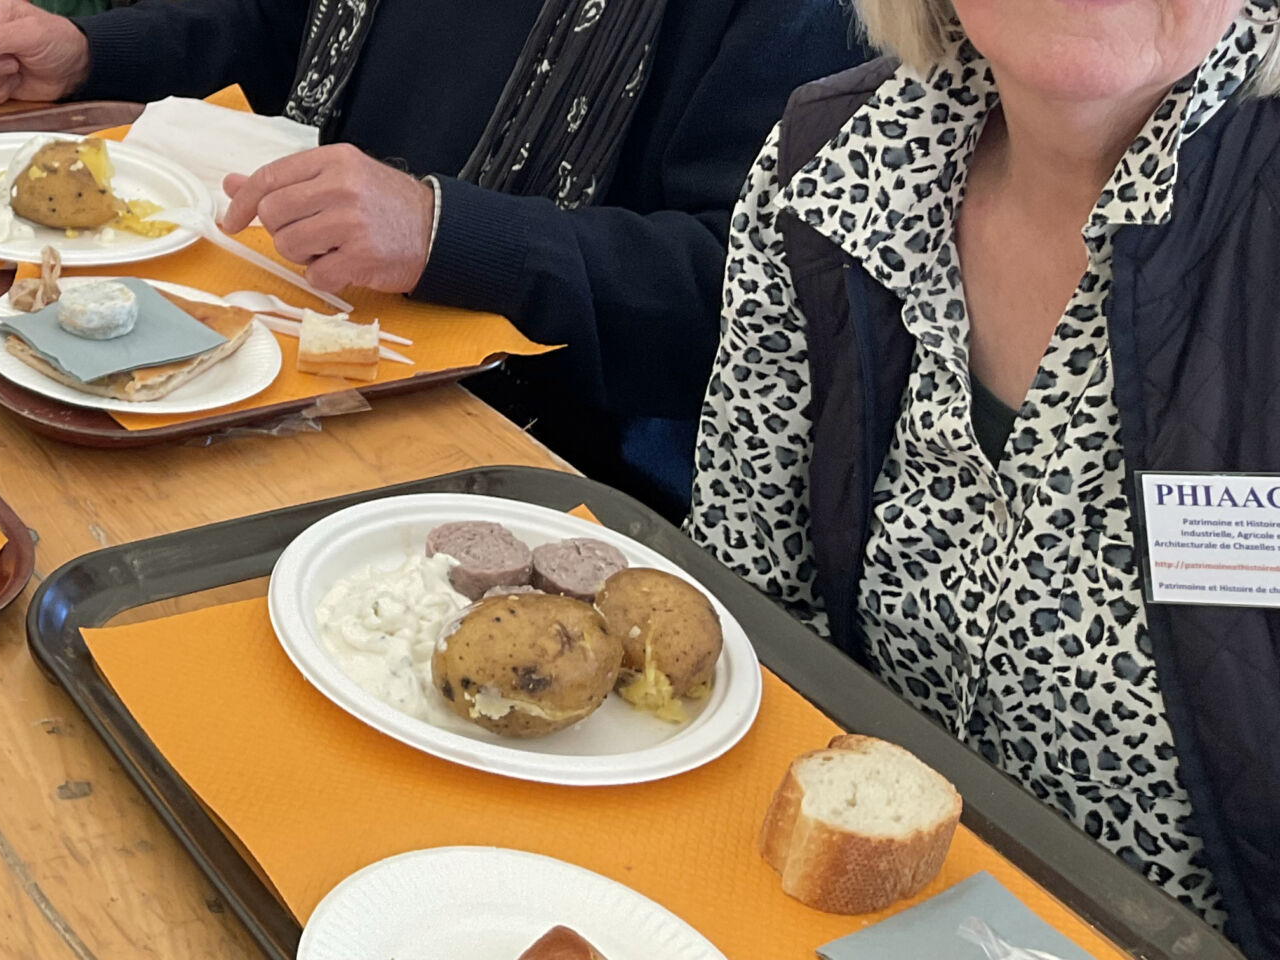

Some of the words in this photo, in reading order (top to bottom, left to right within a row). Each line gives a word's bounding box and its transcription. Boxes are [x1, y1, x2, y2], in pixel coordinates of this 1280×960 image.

[1182, 518, 1232, 527] Patrimoine
[1237, 531, 1274, 540] Agricole
[1154, 540, 1217, 549] Architecturale
[1219, 542, 1231, 550] de
[1233, 542, 1275, 551] Chazelles
[1159, 582, 1206, 590] Patrimoine
